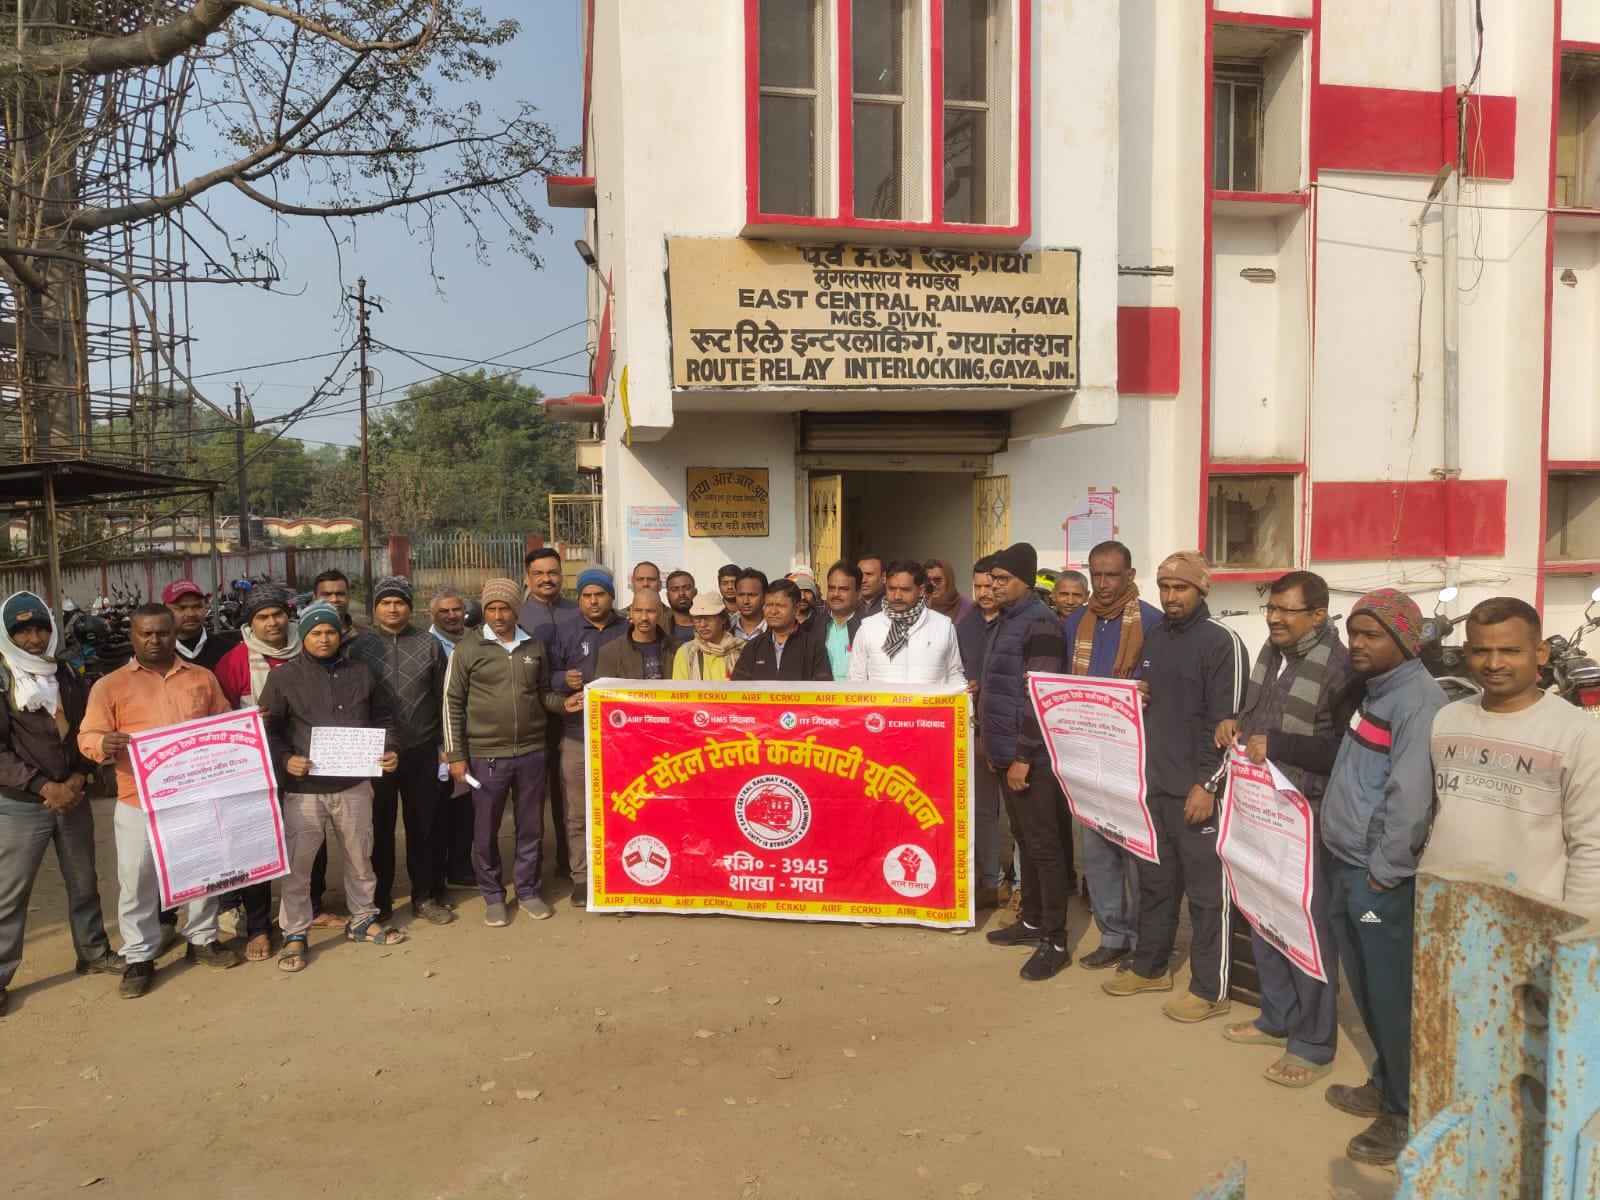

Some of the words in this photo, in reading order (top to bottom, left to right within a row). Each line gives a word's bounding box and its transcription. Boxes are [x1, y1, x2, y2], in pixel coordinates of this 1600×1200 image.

[813, 269, 901, 290] मुगलसराय
[906, 272, 961, 292] मण्डल
[739, 288, 808, 309] EAST
[815, 290, 918, 311] CENTRAL
[831, 311, 882, 328] MGS.
[690, 328, 733, 353] रूट
[735, 319, 788, 353] रिले
[686, 358, 755, 382] ROUTE
[760, 357, 834, 381] RELAY
[671, 691, 690, 700] AIRF
[695, 692, 728, 700] ECRKU
[742, 693, 761, 701] AIRF
[770, 693, 800, 702] ECRKU
[815, 694, 836, 703] AIRF
[845, 695, 876, 703] ECRKU
[923, 696, 955, 705] ECRKU
[888, 720, 914, 728] ECRKU
[611, 774, 654, 821] ईस्ट
[646, 752, 705, 789] सेंट्रल
[704, 732, 761, 769] रेलवे
[764, 735, 864, 780] कर्मचारी
[863, 759, 944, 830] यूनियन
[1464, 775, 1523, 795] EXPOUND
[737, 784, 753, 810] CENTRAL
[752, 776, 779, 787] RAILWAY
[769, 834, 799, 848] STRENGTH
[782, 858, 828, 875] 3945
[729, 875, 775, 891] शाखा
[790, 877, 824, 893] गया
[605, 896, 625, 904] AIRF
[633, 896, 662, 905] ECRKU
[676, 898, 695, 906] AIRF
[703, 899, 733, 908] ECRKU
[746, 901, 767, 909] AIRF
[776, 903, 806, 912] ECRKU
[821, 904, 843, 912] AIRF
[851, 905, 881, 914] ECRKU
[896, 907, 918, 916] AIRF
[926, 909, 957, 919] ECRKU
